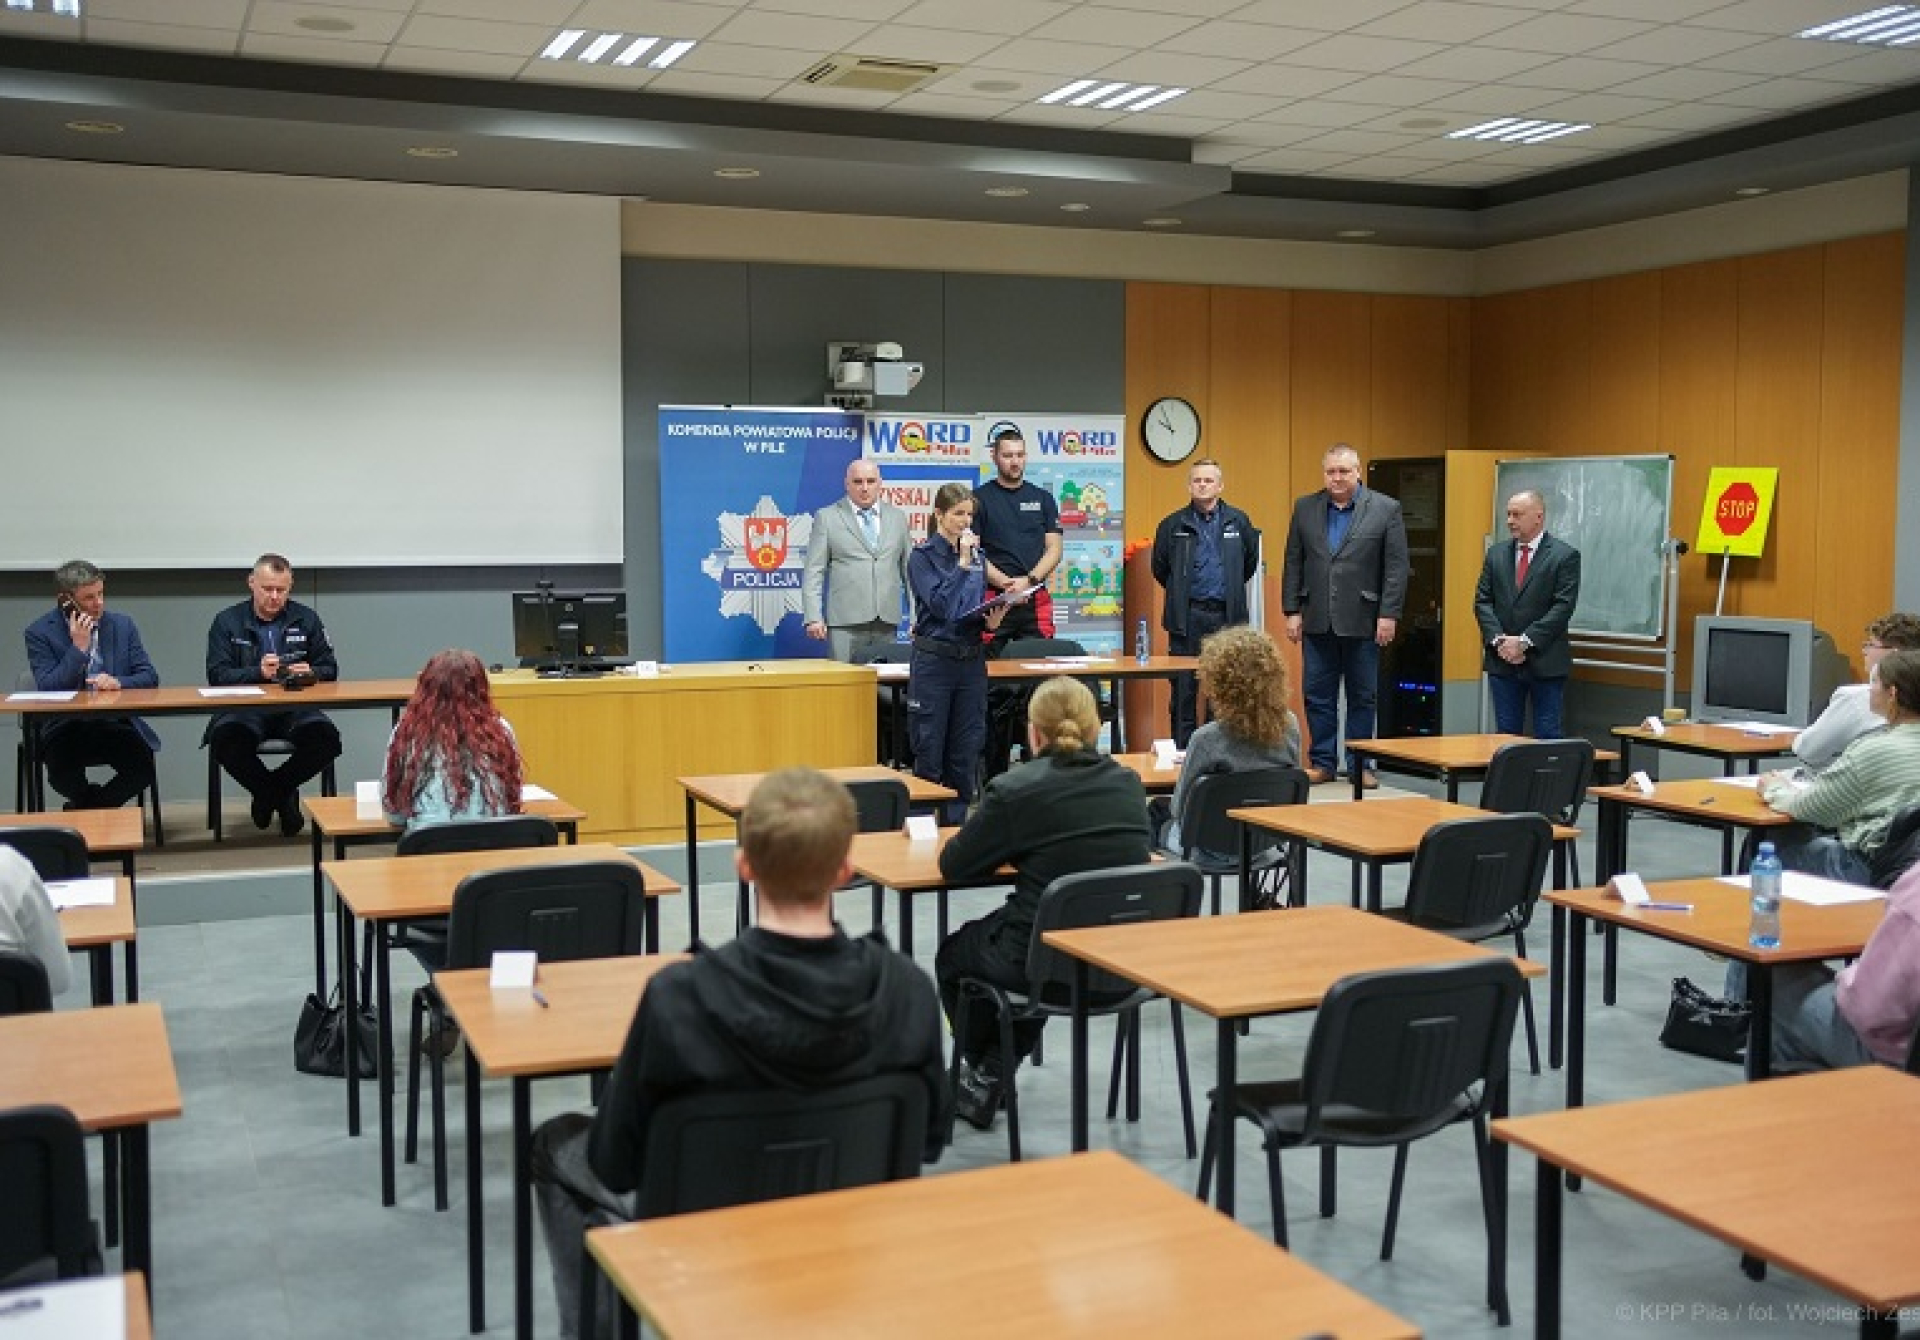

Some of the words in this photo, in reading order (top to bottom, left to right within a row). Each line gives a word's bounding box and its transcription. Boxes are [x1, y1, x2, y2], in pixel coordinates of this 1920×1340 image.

[667, 424, 732, 437] KOMENDA
[733, 424, 813, 438] POWIATOWA
[868, 421, 971, 454] WORD
[743, 441, 759, 454] W
[760, 442, 787, 454] PILE
[1037, 429, 1117, 455] WORD
[1719, 500, 1755, 518] STOP
[733, 572, 800, 587] POLICJA
